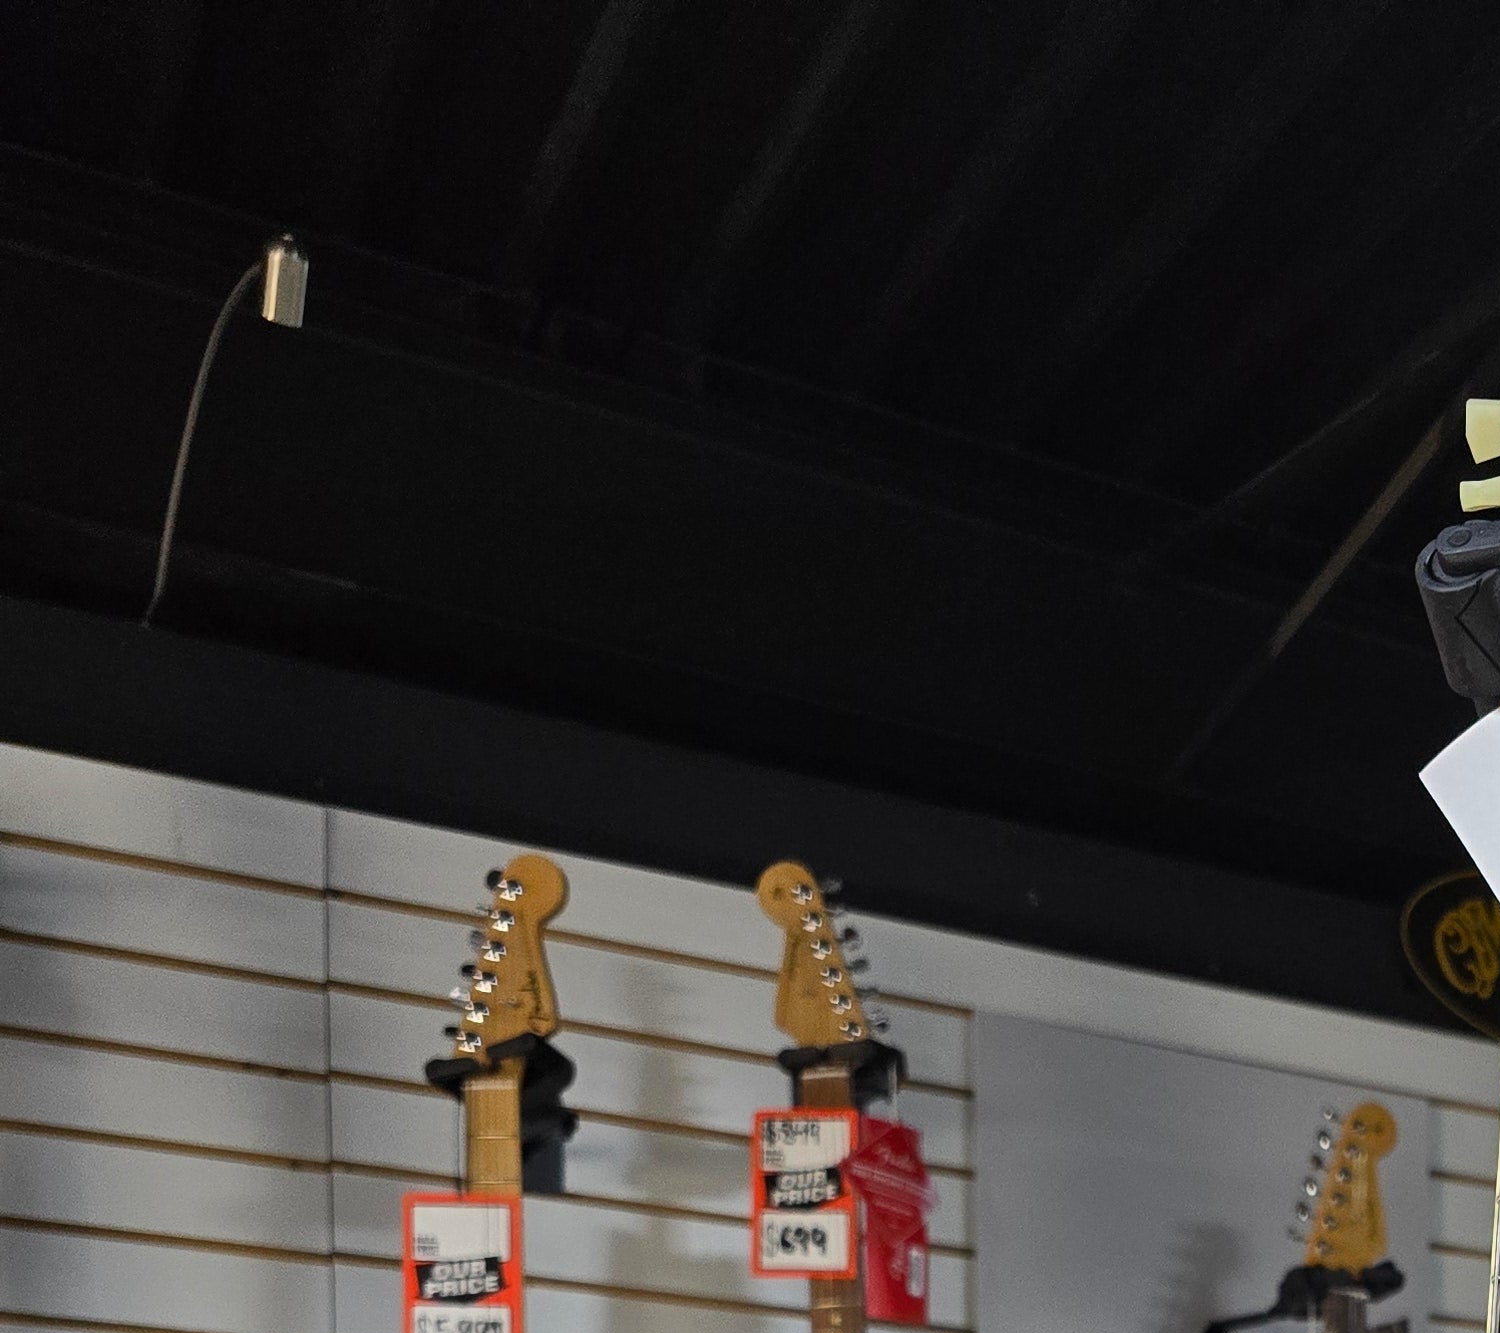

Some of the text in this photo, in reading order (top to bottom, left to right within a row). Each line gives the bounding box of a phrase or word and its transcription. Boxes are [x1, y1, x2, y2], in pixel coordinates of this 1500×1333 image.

[779, 1169, 828, 1191] OUR
[772, 1184, 837, 1208] PRICE
[432, 1258, 487, 1281] OUR
[424, 1275, 500, 1299] PRICE
